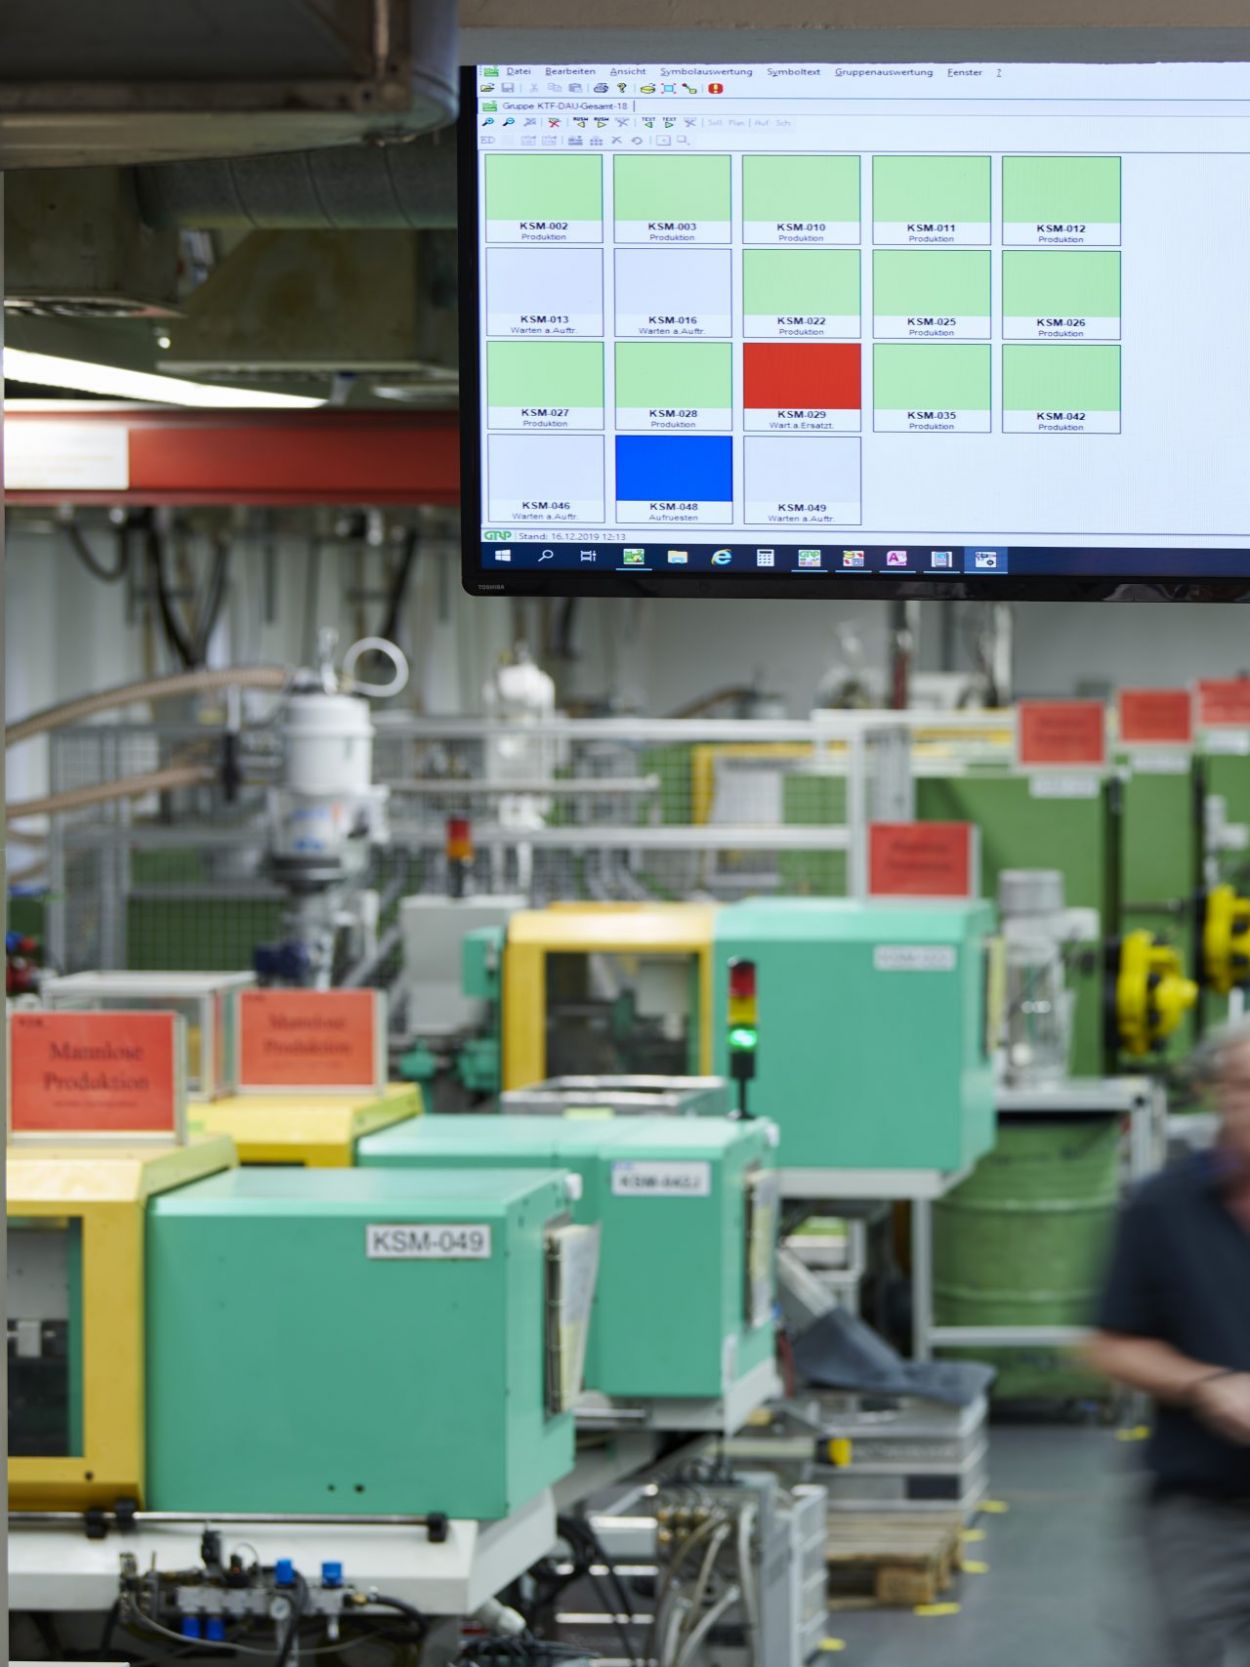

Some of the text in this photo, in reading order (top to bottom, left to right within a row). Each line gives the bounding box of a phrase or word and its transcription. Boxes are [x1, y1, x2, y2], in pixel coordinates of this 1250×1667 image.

[506, 67, 532, 76] Datei
[545, 67, 596, 76] Bearbeiten
[610, 67, 646, 76] Ansicht
[660, 67, 753, 78] Symbolauswertung
[767, 68, 821, 77] Symboltext
[835, 68, 933, 78] Gruppenauswertung
[948, 69, 982, 78] Fenster
[502, 101, 534, 112] Gruppe
[520, 222, 568, 230] KSM-002
[648, 223, 696, 231] KSM-003
[908, 224, 956, 232] KSM-011
[1037, 319, 1085, 327] KSM-026
[522, 409, 569, 417] KSM-027
[650, 410, 697, 418] KSM-028
[522, 502, 570, 510] KSM-046
[650, 503, 698, 511] KSM-048
[778, 504, 826, 512] KSM-049
[519, 532, 626, 541] Stand: 16.12.2019 12:13
[373, 1231, 484, 1251] KSM-049
